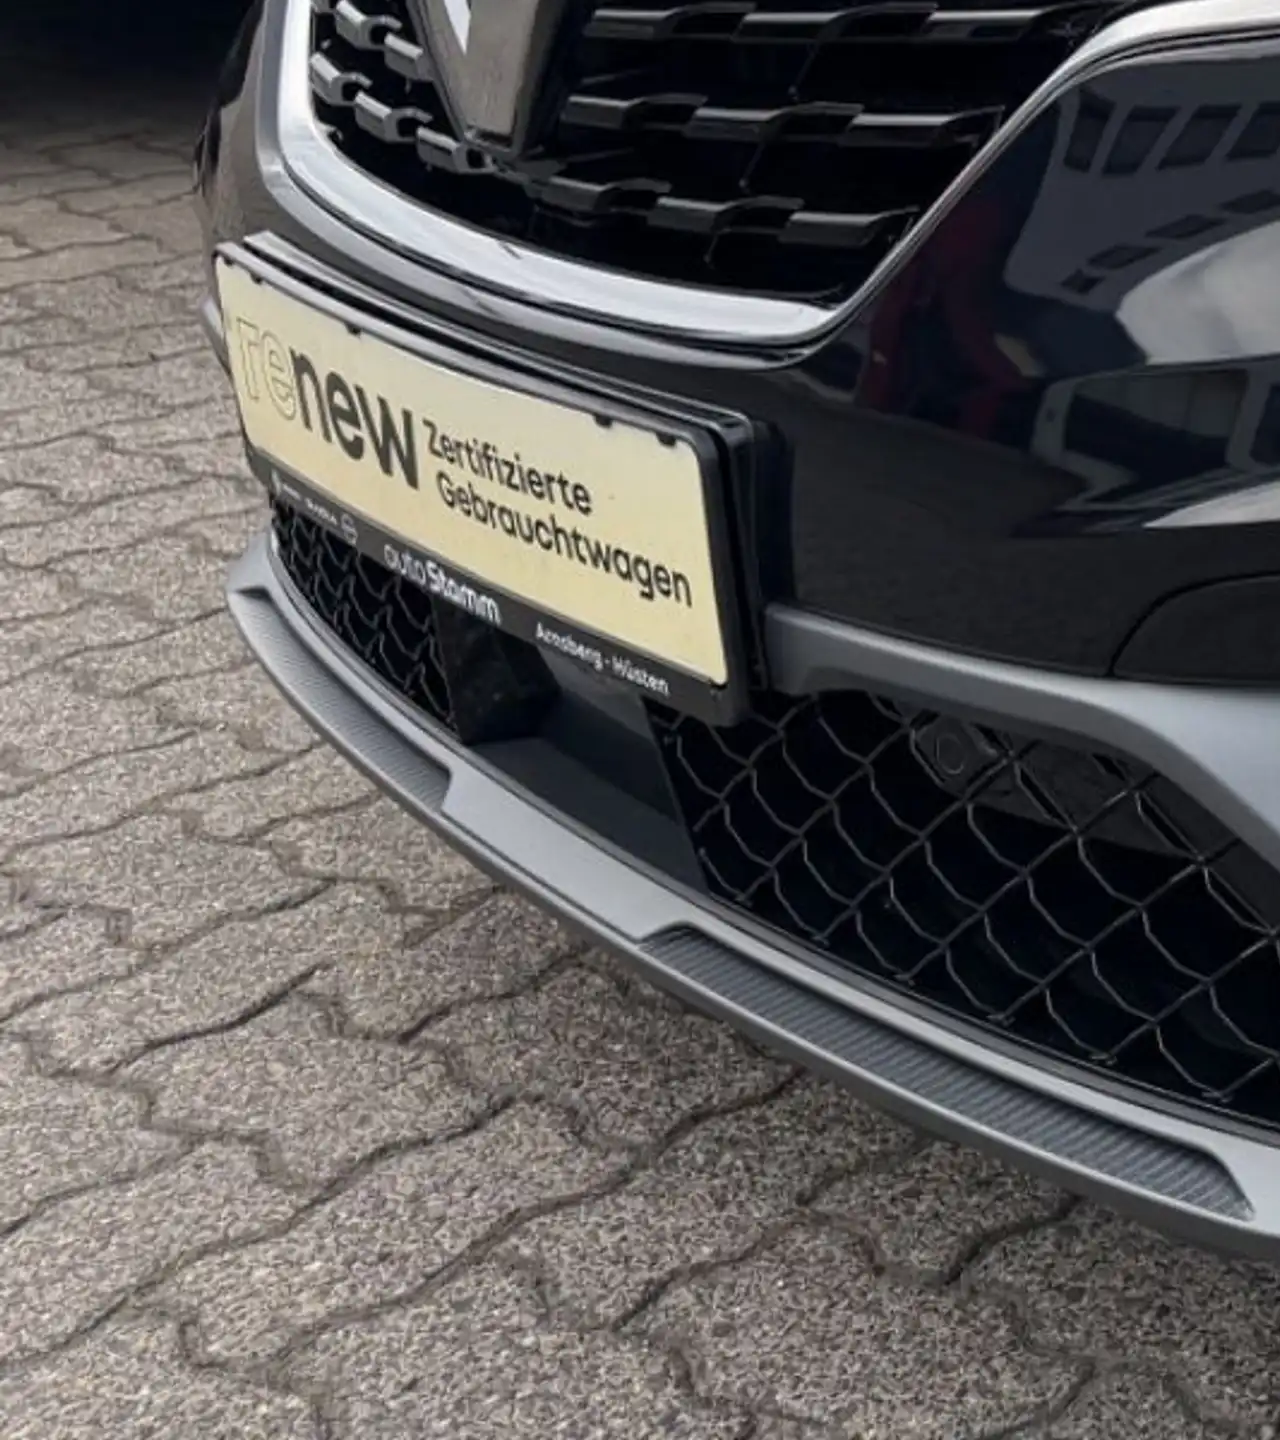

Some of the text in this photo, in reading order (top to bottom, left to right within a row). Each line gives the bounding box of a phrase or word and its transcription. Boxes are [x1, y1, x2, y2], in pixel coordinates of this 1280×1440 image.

[236, 316, 420, 491] renew
[424, 418, 592, 517] Zertifizierte
[437, 472, 693, 608] Gebrauchtwagen
